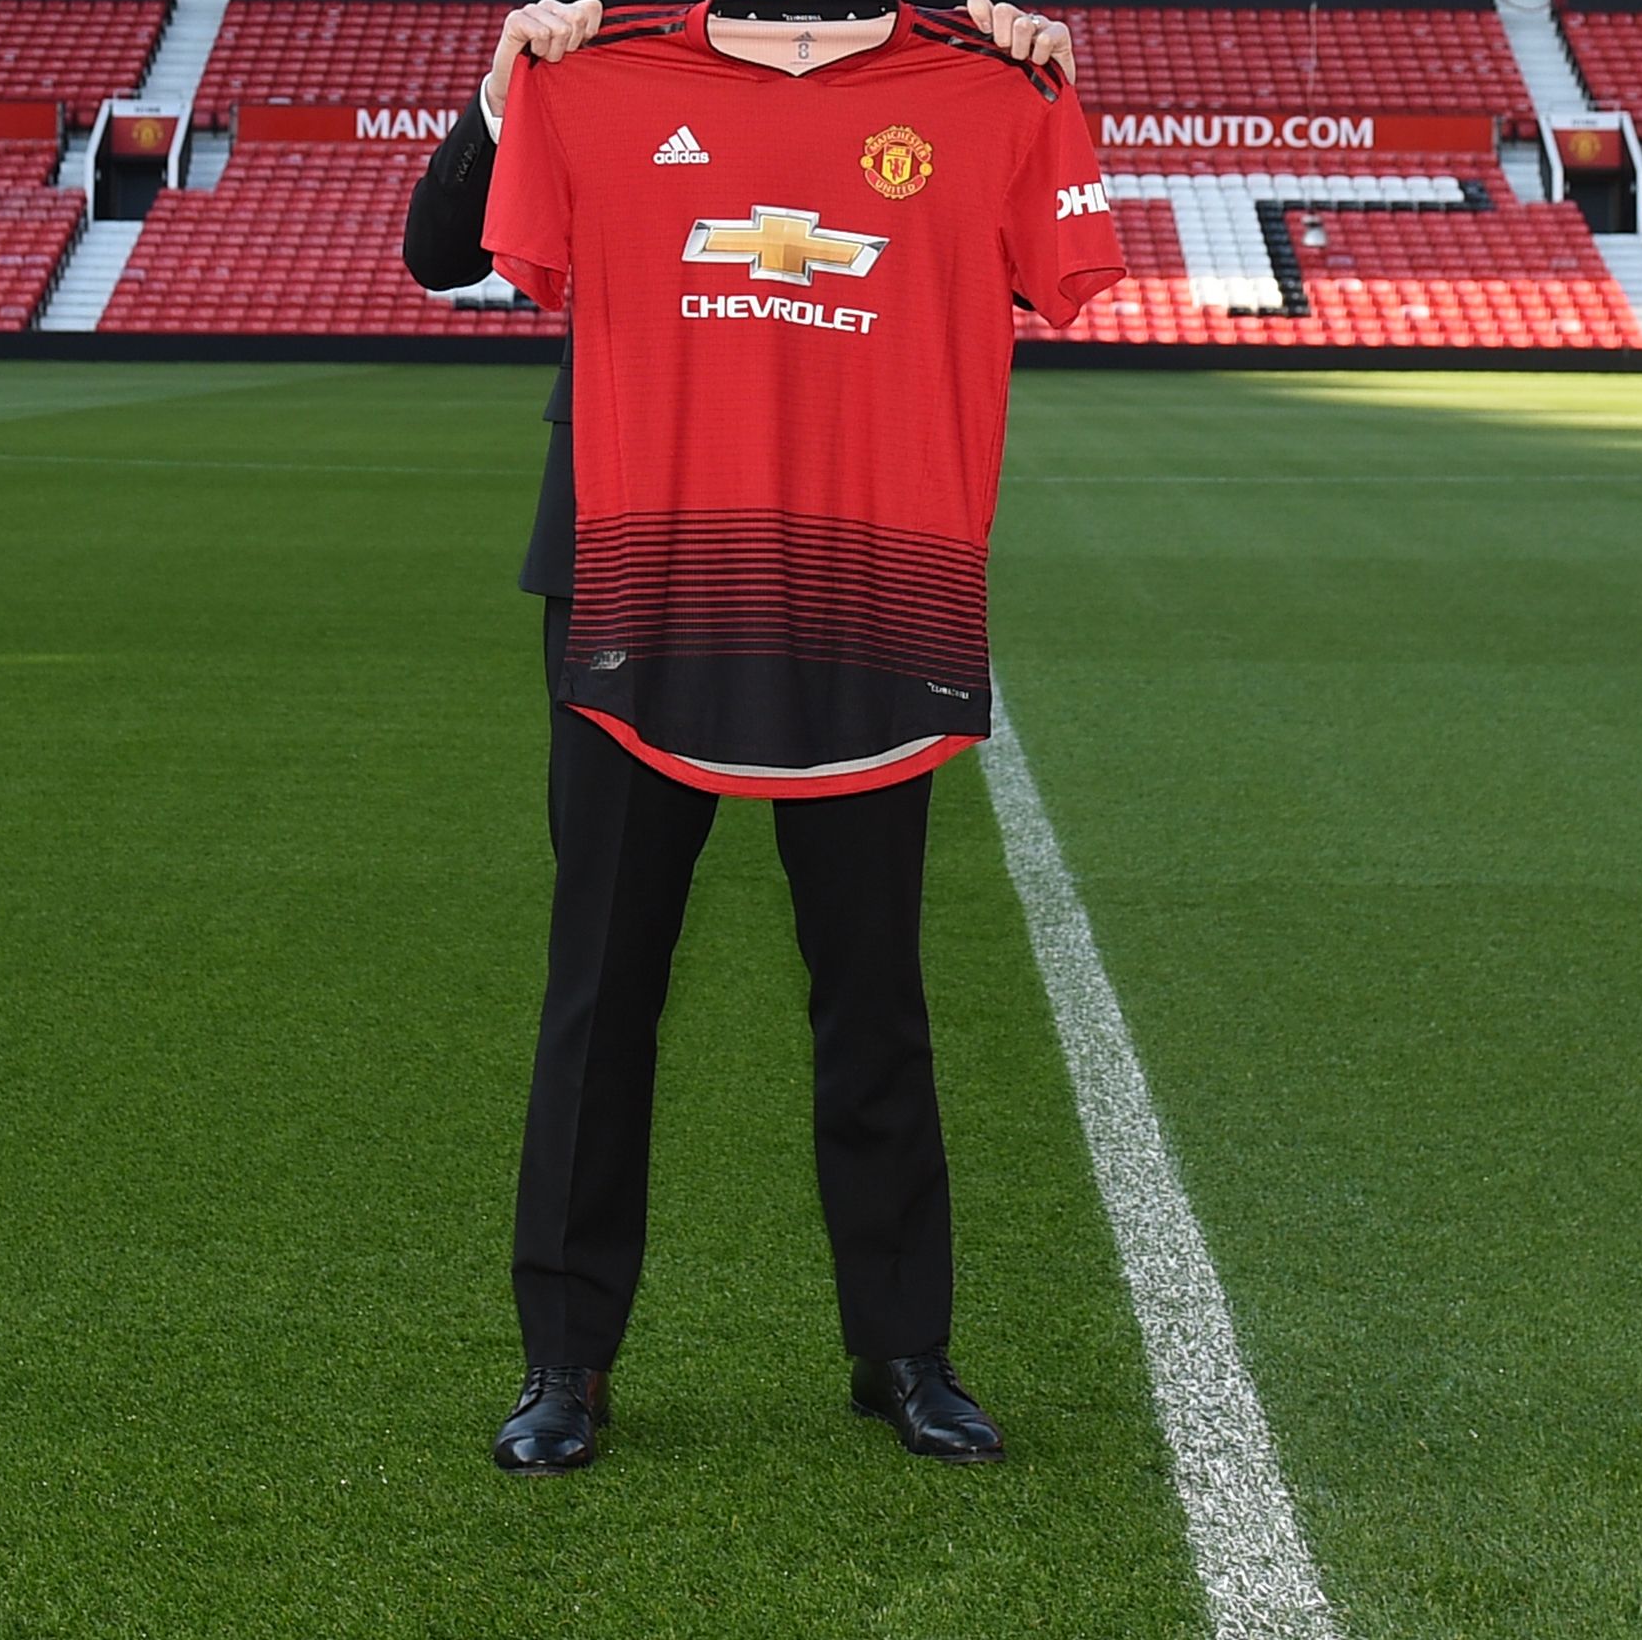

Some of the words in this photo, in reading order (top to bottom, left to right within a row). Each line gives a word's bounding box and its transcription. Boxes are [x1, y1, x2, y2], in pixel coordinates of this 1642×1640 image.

[1101, 114, 1375, 148] MANUTD.COM
[653, 150, 710, 165] adidas
[875, 179, 916, 195] UNITED
[680, 295, 879, 335] CHEVROLET
